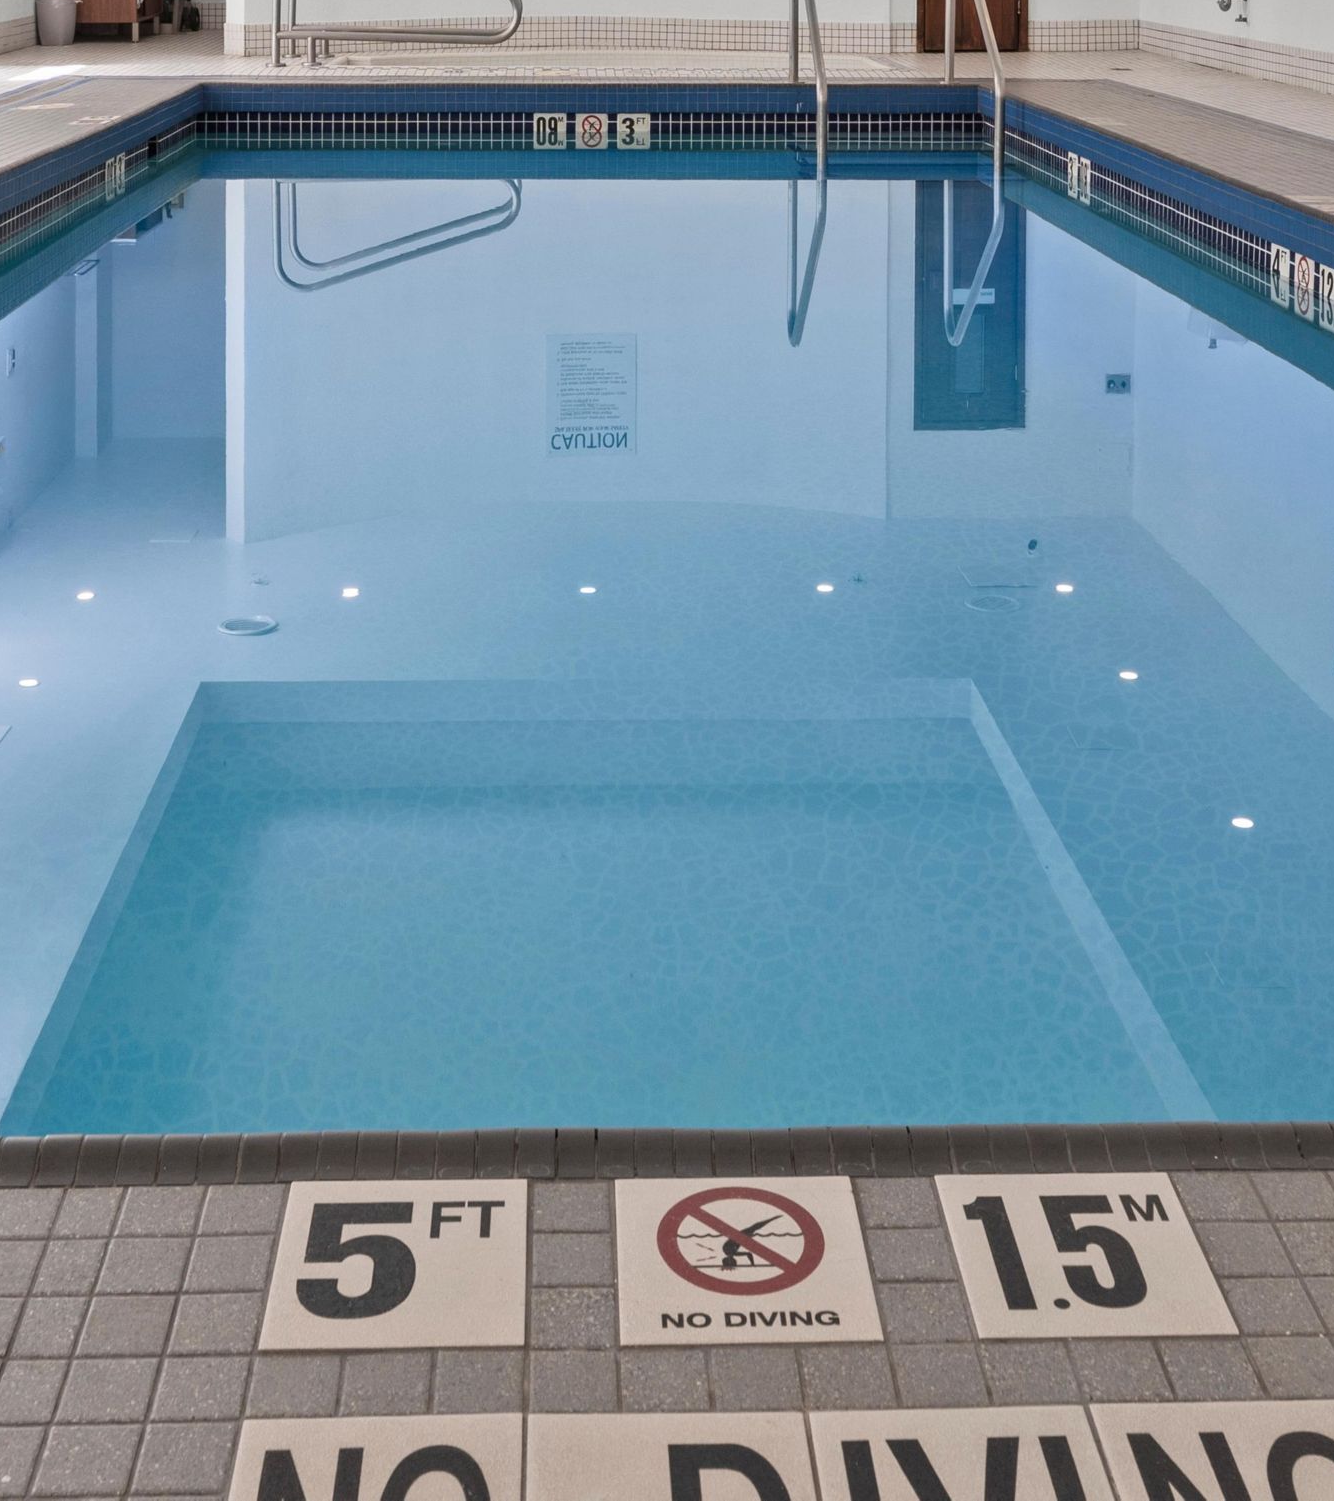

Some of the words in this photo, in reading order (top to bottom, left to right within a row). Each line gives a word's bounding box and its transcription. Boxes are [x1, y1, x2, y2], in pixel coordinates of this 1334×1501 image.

[621, 117, 635, 142] 3
[1272, 248, 1280, 276] 4
[297, 1202, 415, 1319] 5
[430, 1201, 505, 1238] FT
[964, 1195, 1146, 1310] 1.5
[1119, 1194, 1169, 1221] M
[661, 1312, 712, 1329] NO
[724, 1310, 840, 1328] DIVING
